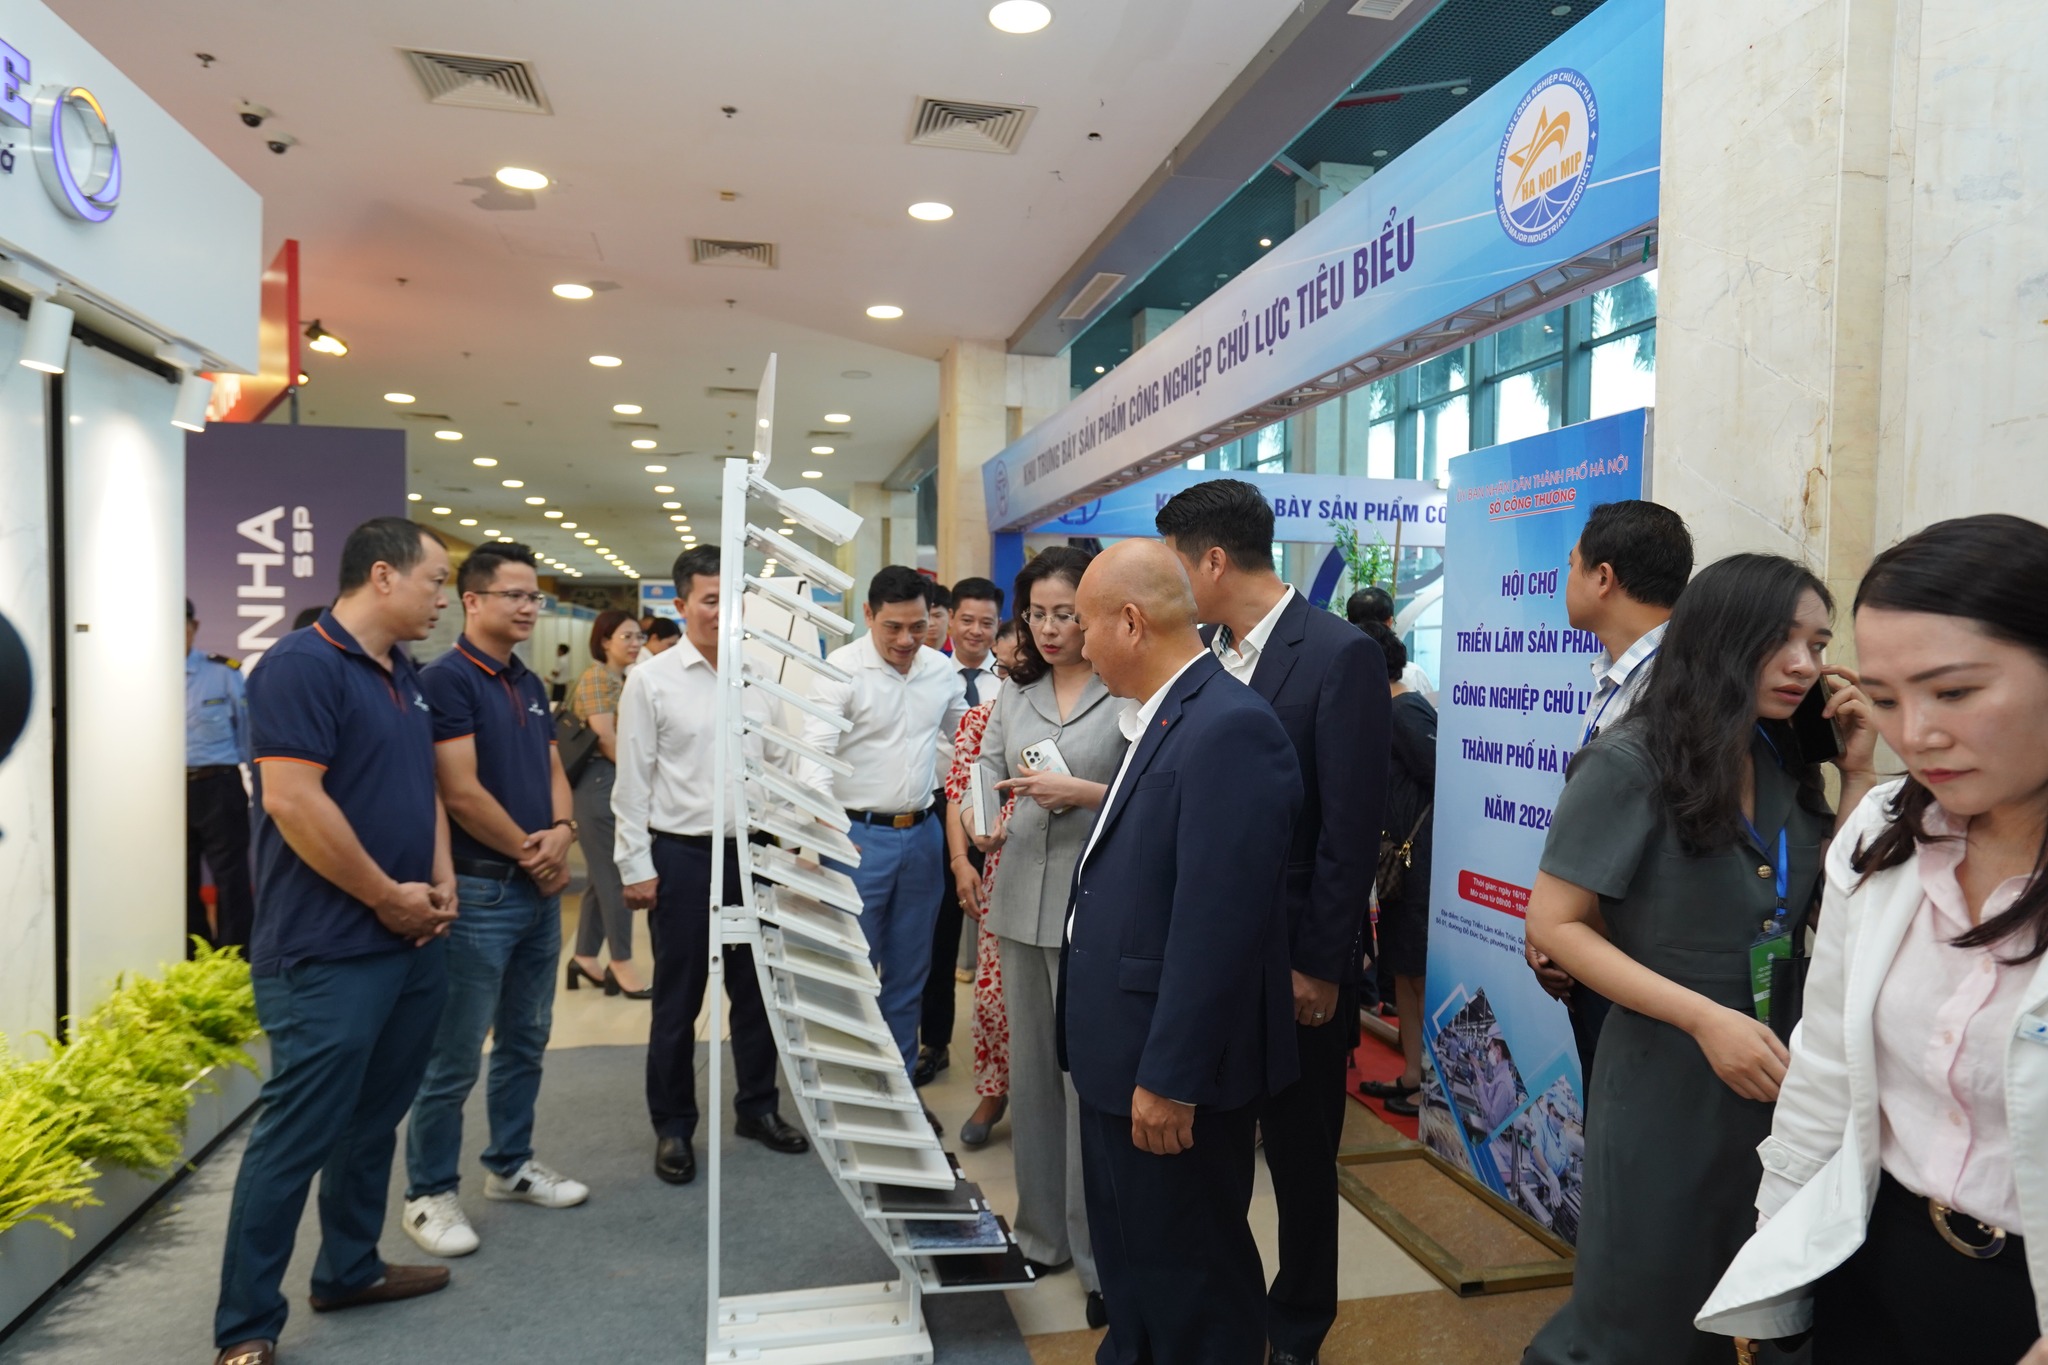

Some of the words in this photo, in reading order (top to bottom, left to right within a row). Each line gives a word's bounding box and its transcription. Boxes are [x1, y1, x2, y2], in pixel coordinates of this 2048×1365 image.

[1560, 150, 1582, 180] MIP
[1498, 203, 1509, 230] HANOI
[1507, 226, 1528, 243] MAJOR
[1527, 214, 1567, 243] INDUSTRIAL
[1565, 154, 1594, 216] PRODUCTS
[1062, 431, 1077, 465] BÀY
[1079, 415, 1096, 456] SẢN
[1098, 394, 1126, 445] PHẨM
[1129, 380, 1159, 427] CÔNG
[1163, 345, 1212, 408] NGHIỆP
[1217, 309, 1249, 375] CHỦ
[1255, 296, 1290, 356] LỰC
[1296, 260, 1345, 330] TIÊU
[1353, 206, 1415, 299] BIỂU
[1467, 486, 1485, 501] BAN
[1511, 475, 1532, 492] DÂN
[1533, 469, 1564, 488] THÀNH
[1565, 459, 1589, 483] PHỐ
[1590, 457, 1606, 478] HÀ
[1607, 453, 1629, 476] NỘI
[1274, 494, 1312, 518] BÀY
[1318, 494, 1357, 520] SẢN
[1364, 496, 1419, 523] PHẨM
[1503, 495, 1532, 513] CÔNG
[1534, 487, 1577, 508] THƯƠNG
[292, 505, 314, 578] SSP
[236, 505, 286, 680] NHA
[1501, 569, 1525, 601] HỘI
[1528, 568, 1559, 599] CHỢ
[1456, 622, 1492, 653] TRIỂN
[1494, 626, 1524, 653] LÃM
[1527, 622, 1558, 653] SẢN
[1452, 680, 1486, 708] CÔNG
[1489, 683, 1540, 716] NGHIỆP
[1543, 682, 1574, 714] CHỦ
[1461, 736, 1503, 765] THÀNH
[1506, 739, 1536, 770] PHỐ
[1537, 744, 1558, 773] HÀ
[1484, 794, 1516, 824] NĂM
[1460, 915, 1472, 927] Cung
